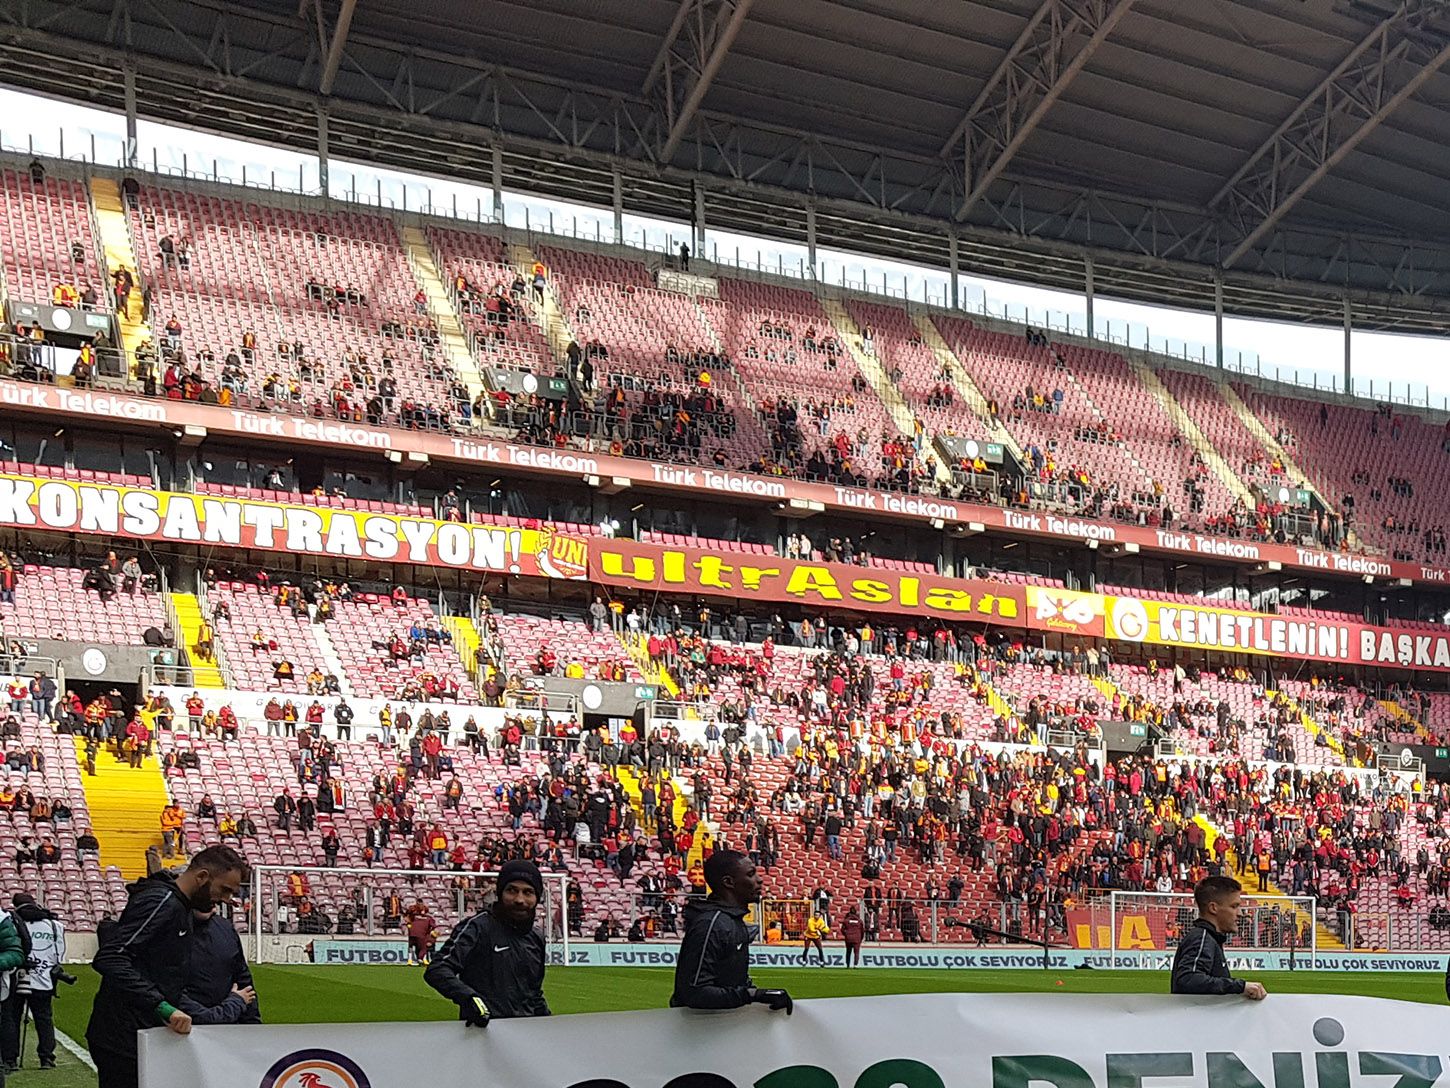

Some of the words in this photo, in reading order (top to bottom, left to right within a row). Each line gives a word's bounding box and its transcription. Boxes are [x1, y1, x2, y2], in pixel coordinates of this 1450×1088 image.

[54, 388, 167, 421] Telekom
[231, 410, 286, 437] Türk
[292, 415, 391, 448] Telekom
[451, 438, 502, 463] Türk
[507, 445, 598, 473] Telekom
[651, 463, 697, 487] Türk
[701, 469, 786, 497] Telekom
[835, 487, 877, 511] Türk
[881, 493, 958, 520] Telekom
[0, 478, 522, 575] KONSANTRASYON!
[1002, 510, 1041, 532] Türk
[1045, 515, 1116, 540] Telekom
[1156, 530, 1191, 551] Türk
[1195, 535, 1259, 560] Telekom
[1296, 549, 1329, 570] Türk
[1332, 554, 1392, 576] Telekom
[1420, 567, 1446, 581] Türk
[601, 551, 1018, 619] ultrAslan
[1360, 630, 1450, 666] BAŞKA
[863, 955, 939, 967] FUTBOLU
[942, 955, 978, 969] ÇOK
[1342, 958, 1369, 971] ÇOK
